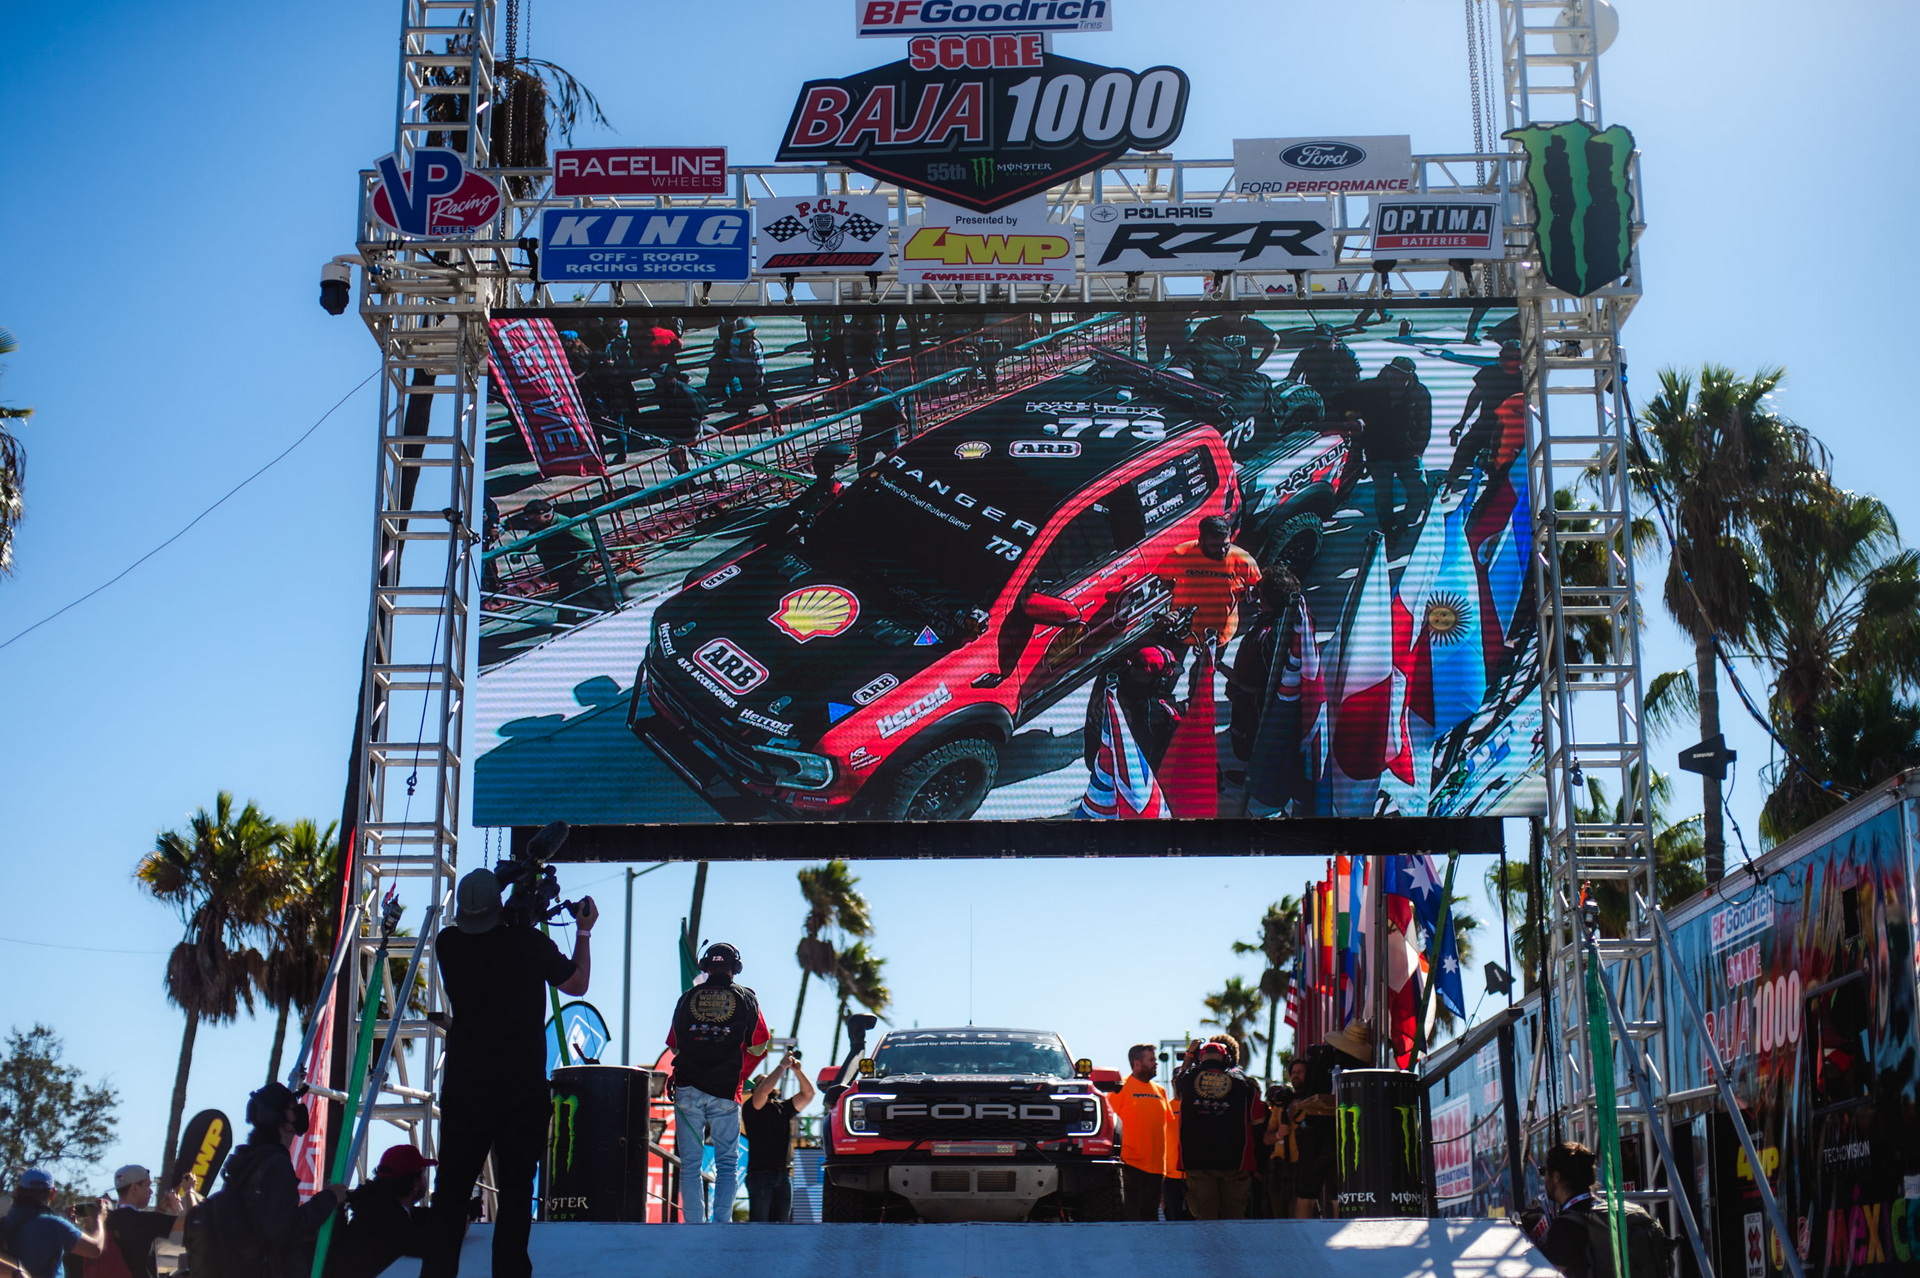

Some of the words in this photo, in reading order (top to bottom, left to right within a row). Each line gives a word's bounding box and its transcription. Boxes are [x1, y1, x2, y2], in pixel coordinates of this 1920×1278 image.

[862, 0, 1108, 25] BFGoodrich
[1079, 20, 1102, 29] Tires
[909, 33, 1043, 71] SCORE
[790, 82, 983, 148] BAJA
[1006, 70, 1180, 143] 1000
[559, 156, 722, 178] RACELINE
[1297, 144, 1349, 167] Ford
[651, 176, 722, 187] WHEELS
[927, 162, 967, 181] 55th
[374, 148, 465, 236] VP
[1240, 182, 1283, 193] FORD
[1286, 178, 1409, 192] PERFORMANCE
[432, 193, 500, 225] Racing
[796, 198, 851, 219] P.C.I.
[1124, 207, 1213, 220] POLARIS
[1383, 204, 1488, 233] OPTIMA
[430, 225, 476, 236] FUELS
[548, 215, 743, 246] KING
[955, 215, 996, 226] Presented
[998, 215, 1018, 228] by
[903, 227, 1071, 266] 4WP
[1097, 220, 1327, 267] RZR
[1401, 236, 1468, 248] BATTERIES
[565, 264, 638, 273] RACING
[642, 264, 717, 273] SHOCKS
[589, 252, 626, 262] OFF
[645, 252, 700, 262] ROAD
[768, 253, 812, 267] RACE
[813, 253, 878, 266] RADIOS
[1058, 417, 1167, 441] 773
[1222, 416, 1255, 450] 773
[1018, 443, 1074, 454] ARB
[879, 473, 901, 494] Powered
[900, 488, 909, 498] by
[908, 493, 926, 507] Shell
[924, 503, 950, 520] Biofuel
[947, 515, 972, 531] Blend
[888, 455, 1038, 537] RANGER
[985, 535, 1023, 562] 773
[705, 567, 736, 587] ARB
[660, 622, 677, 656] Herrod
[701, 645, 758, 687] ARB
[676, 657, 695, 673] 4X4
[690, 670, 739, 709] ACCESSORIES
[860, 677, 893, 701] ARB
[739, 708, 794, 732] Herrod
[875, 681, 949, 736] Herrod
[1711, 885, 1775, 942] BFGoodrich
[1726, 942, 1762, 990] SCORE
[1704, 996, 1750, 1073] BAJA
[1753, 969, 1801, 1055] 1000
[887, 1033, 1057, 1042] RANGER
[1031, 1042, 1062, 1052] 773
[886, 1103, 1061, 1121] FORD
[1823, 1140, 1870, 1164] TECNOVISION
[1436, 1165, 1470, 1187] TERNATIONAL
[546, 1196, 589, 1211] NSTER
[1338, 1192, 1376, 1204] NSTER
